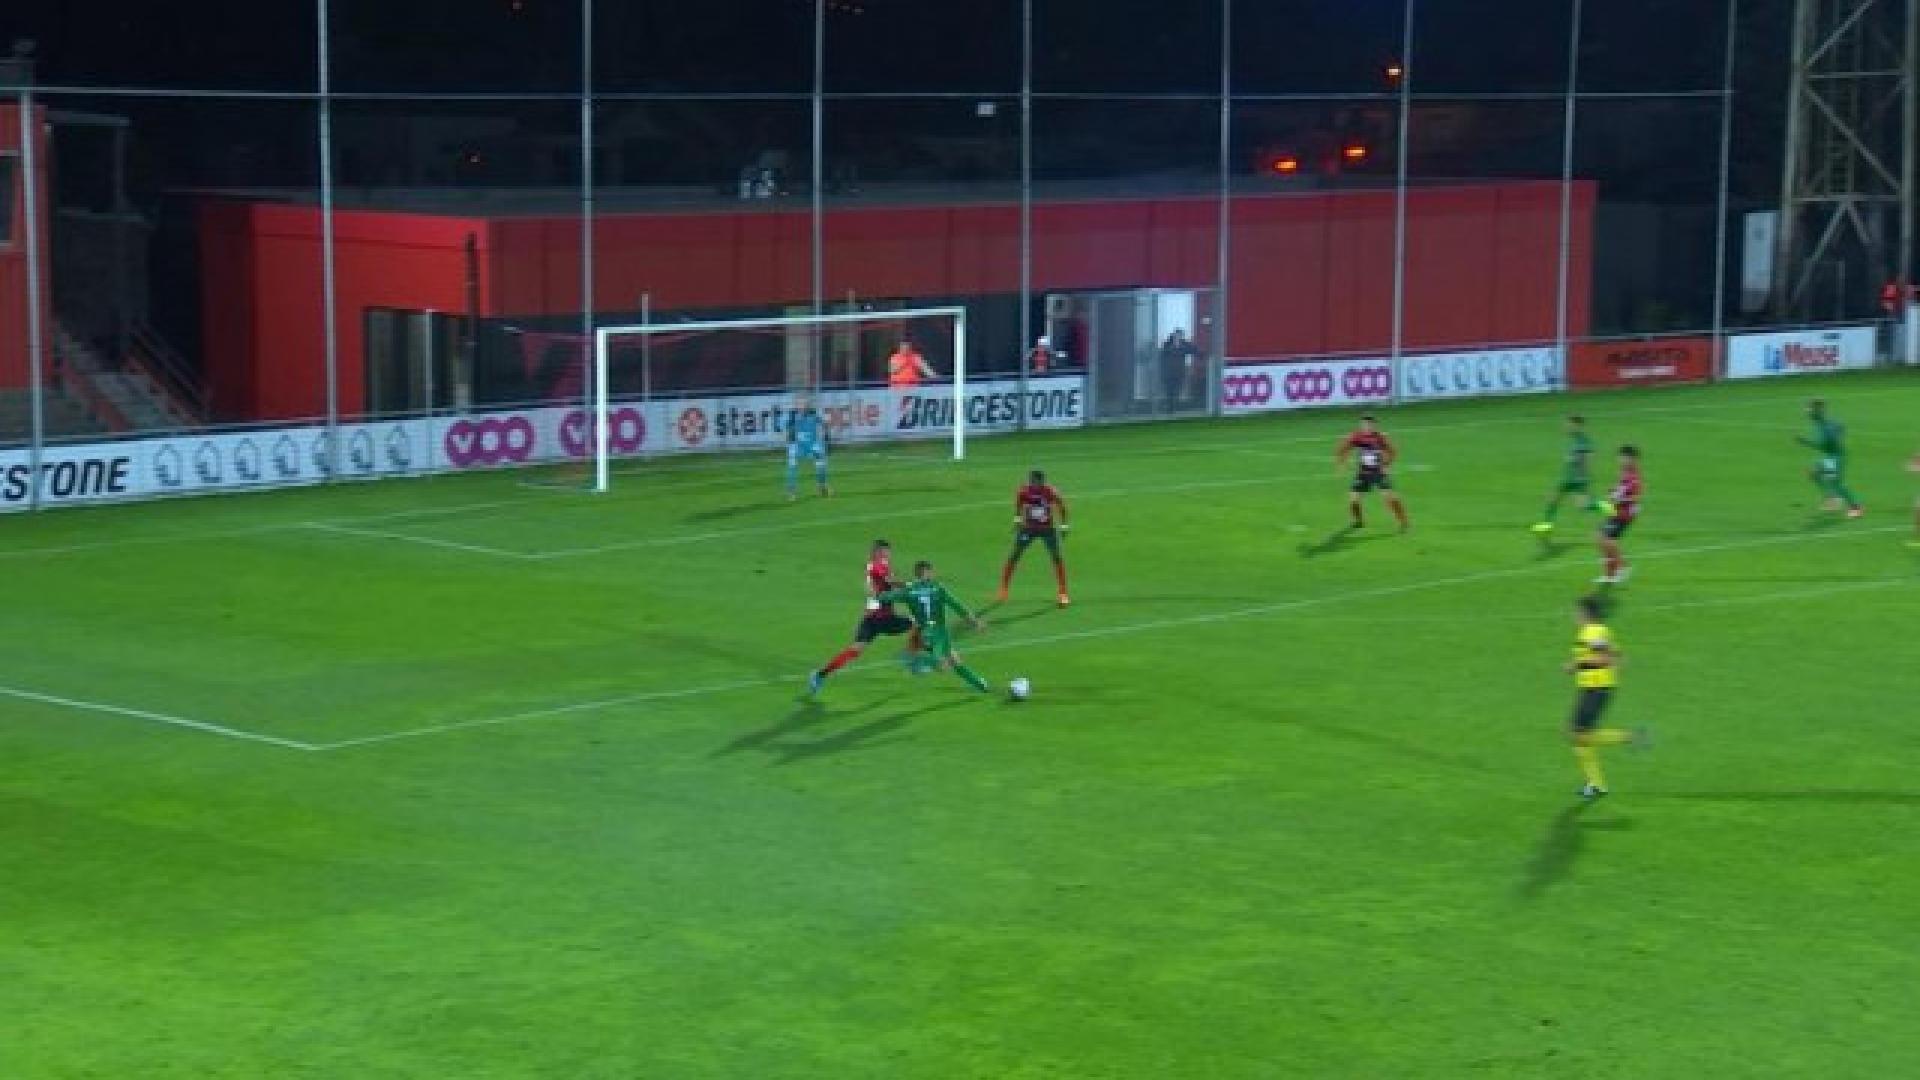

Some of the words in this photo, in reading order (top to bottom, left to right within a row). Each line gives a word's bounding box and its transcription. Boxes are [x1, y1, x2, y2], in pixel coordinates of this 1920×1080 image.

[715, 405, 782, 436] start
[897, 389, 1081, 429] BRIGESTONE
[446, 416, 535, 468] voo
[0, 456, 131, 501] STONE
[918, 596, 932, 622] 7
